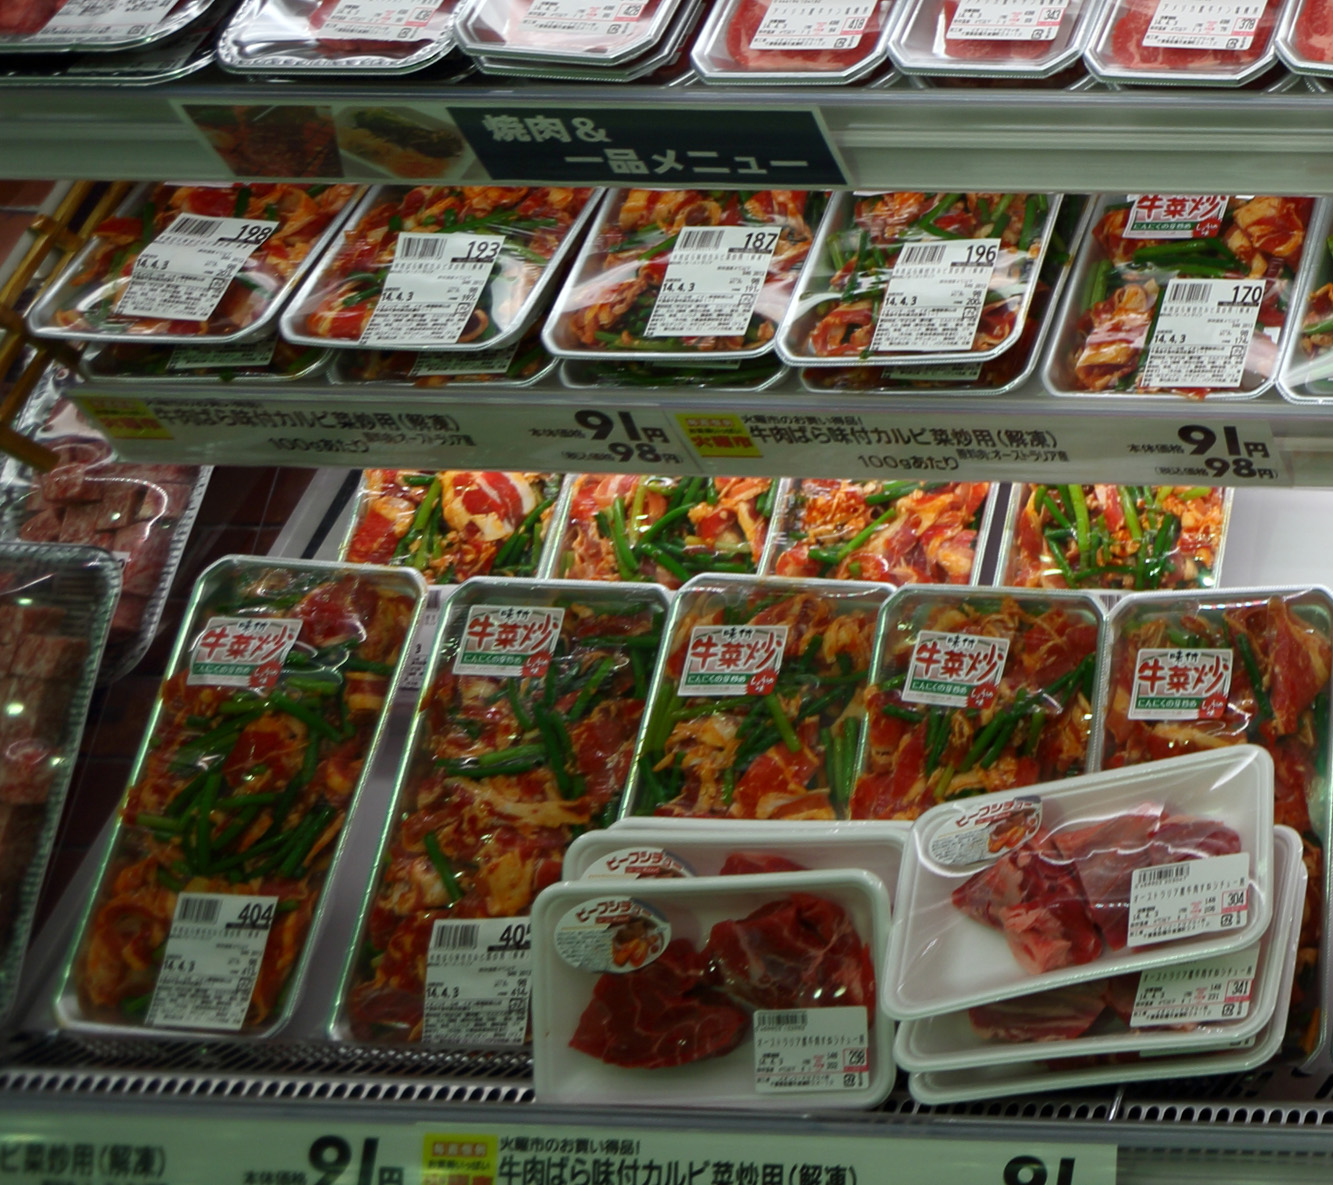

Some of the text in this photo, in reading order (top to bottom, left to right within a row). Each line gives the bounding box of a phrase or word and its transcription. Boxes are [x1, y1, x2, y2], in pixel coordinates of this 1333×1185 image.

[481, 116, 611, 144] 焼肉&
[565, 148, 809, 176] 一品メニュー
[233, 223, 272, 244] 198
[744, 232, 777, 251] 187
[467, 240, 501, 259] 193
[965, 245, 997, 264] 196
[1230, 285, 1262, 305] 170
[575, 410, 669, 443] 91円
[749, 426, 1058, 449] 牛肉ばら味付カルビ菜炒用(解凍)
[1178, 425, 1270, 458] 91円
[858, 454, 959, 472] 100gあたり
[201, 624, 293, 660] 牛菜炒
[468, 614, 560, 650] 牛菜炒
[691, 632, 783, 672] 牛菜炒
[915, 640, 1005, 683] 牛菜炒
[1138, 655, 1230, 696] 牛菜炒
[237, 902, 275, 926] 404
